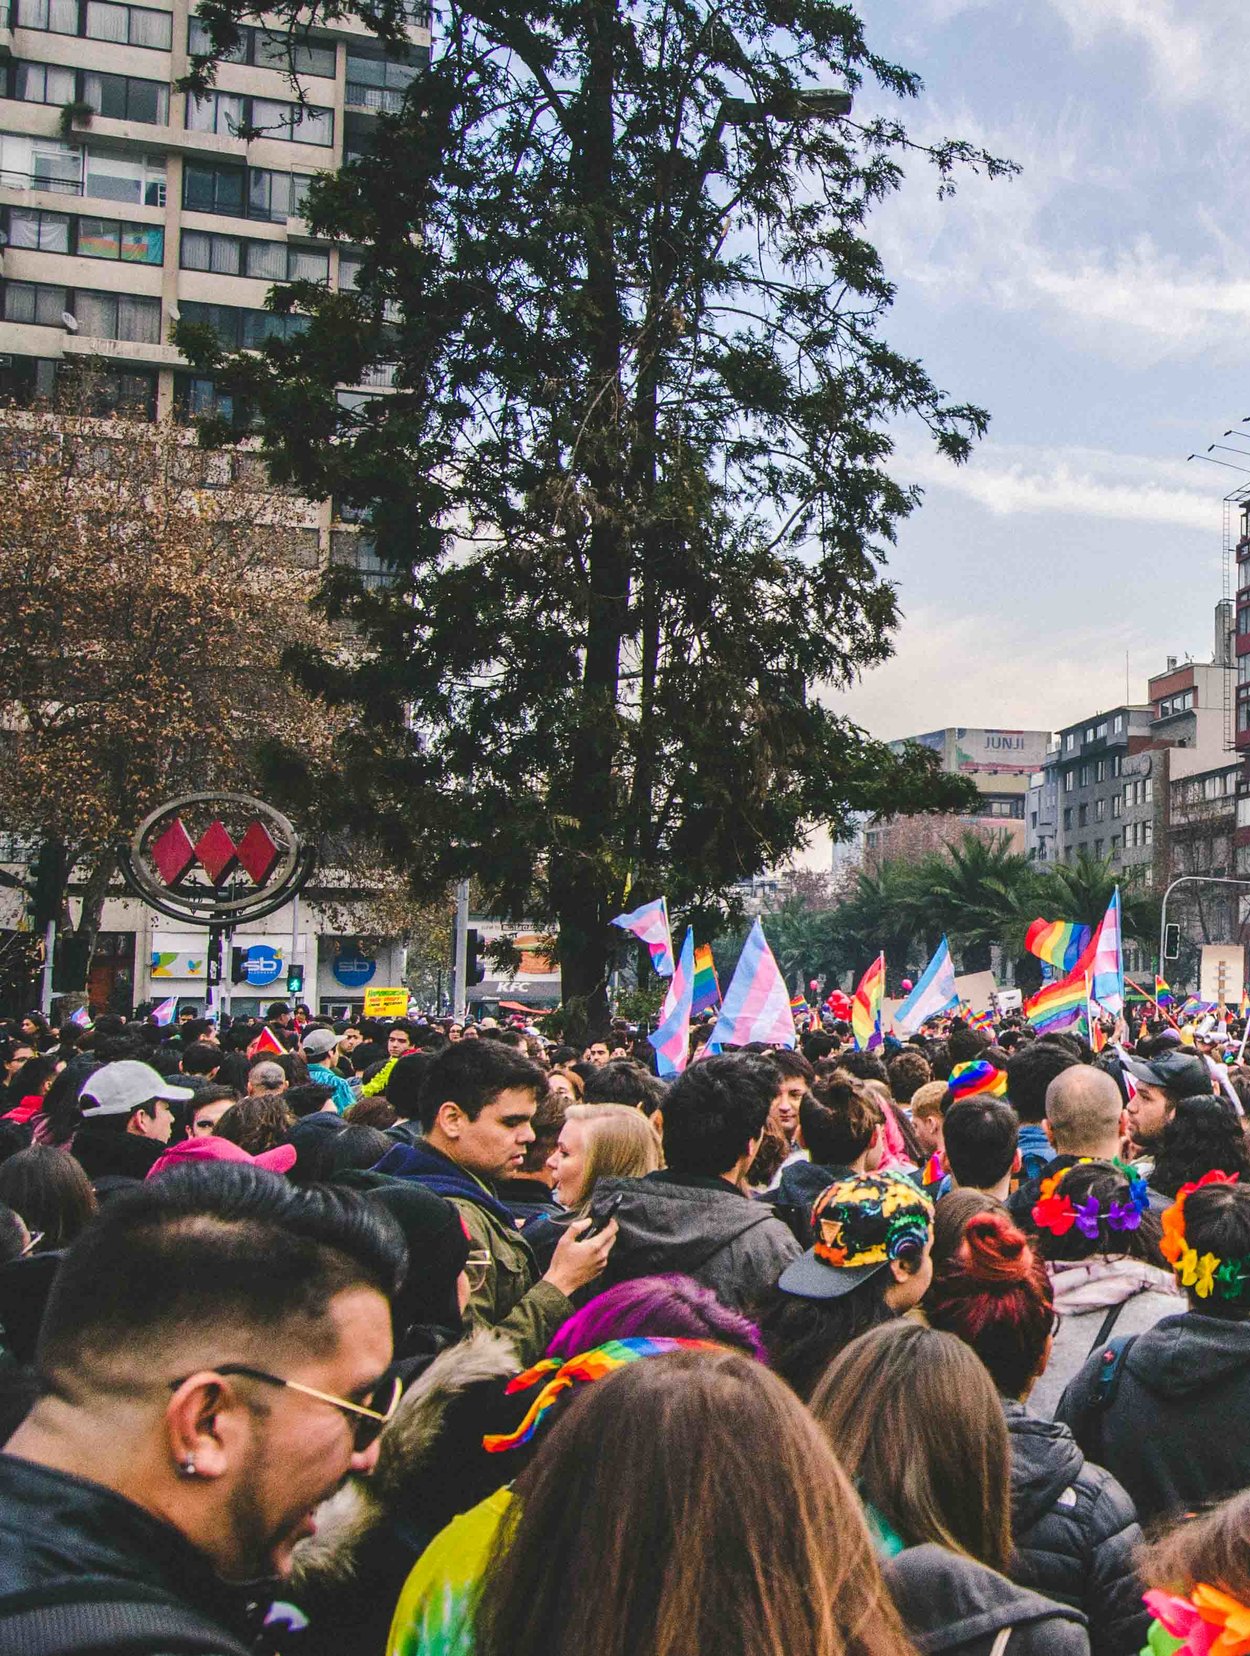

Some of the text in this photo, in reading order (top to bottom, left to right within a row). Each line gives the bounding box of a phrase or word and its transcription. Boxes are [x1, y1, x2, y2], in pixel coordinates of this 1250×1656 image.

[984, 736, 1024, 750] JUNJI
[338, 959, 370, 972] sb
[496, 981, 532, 992] KFC
